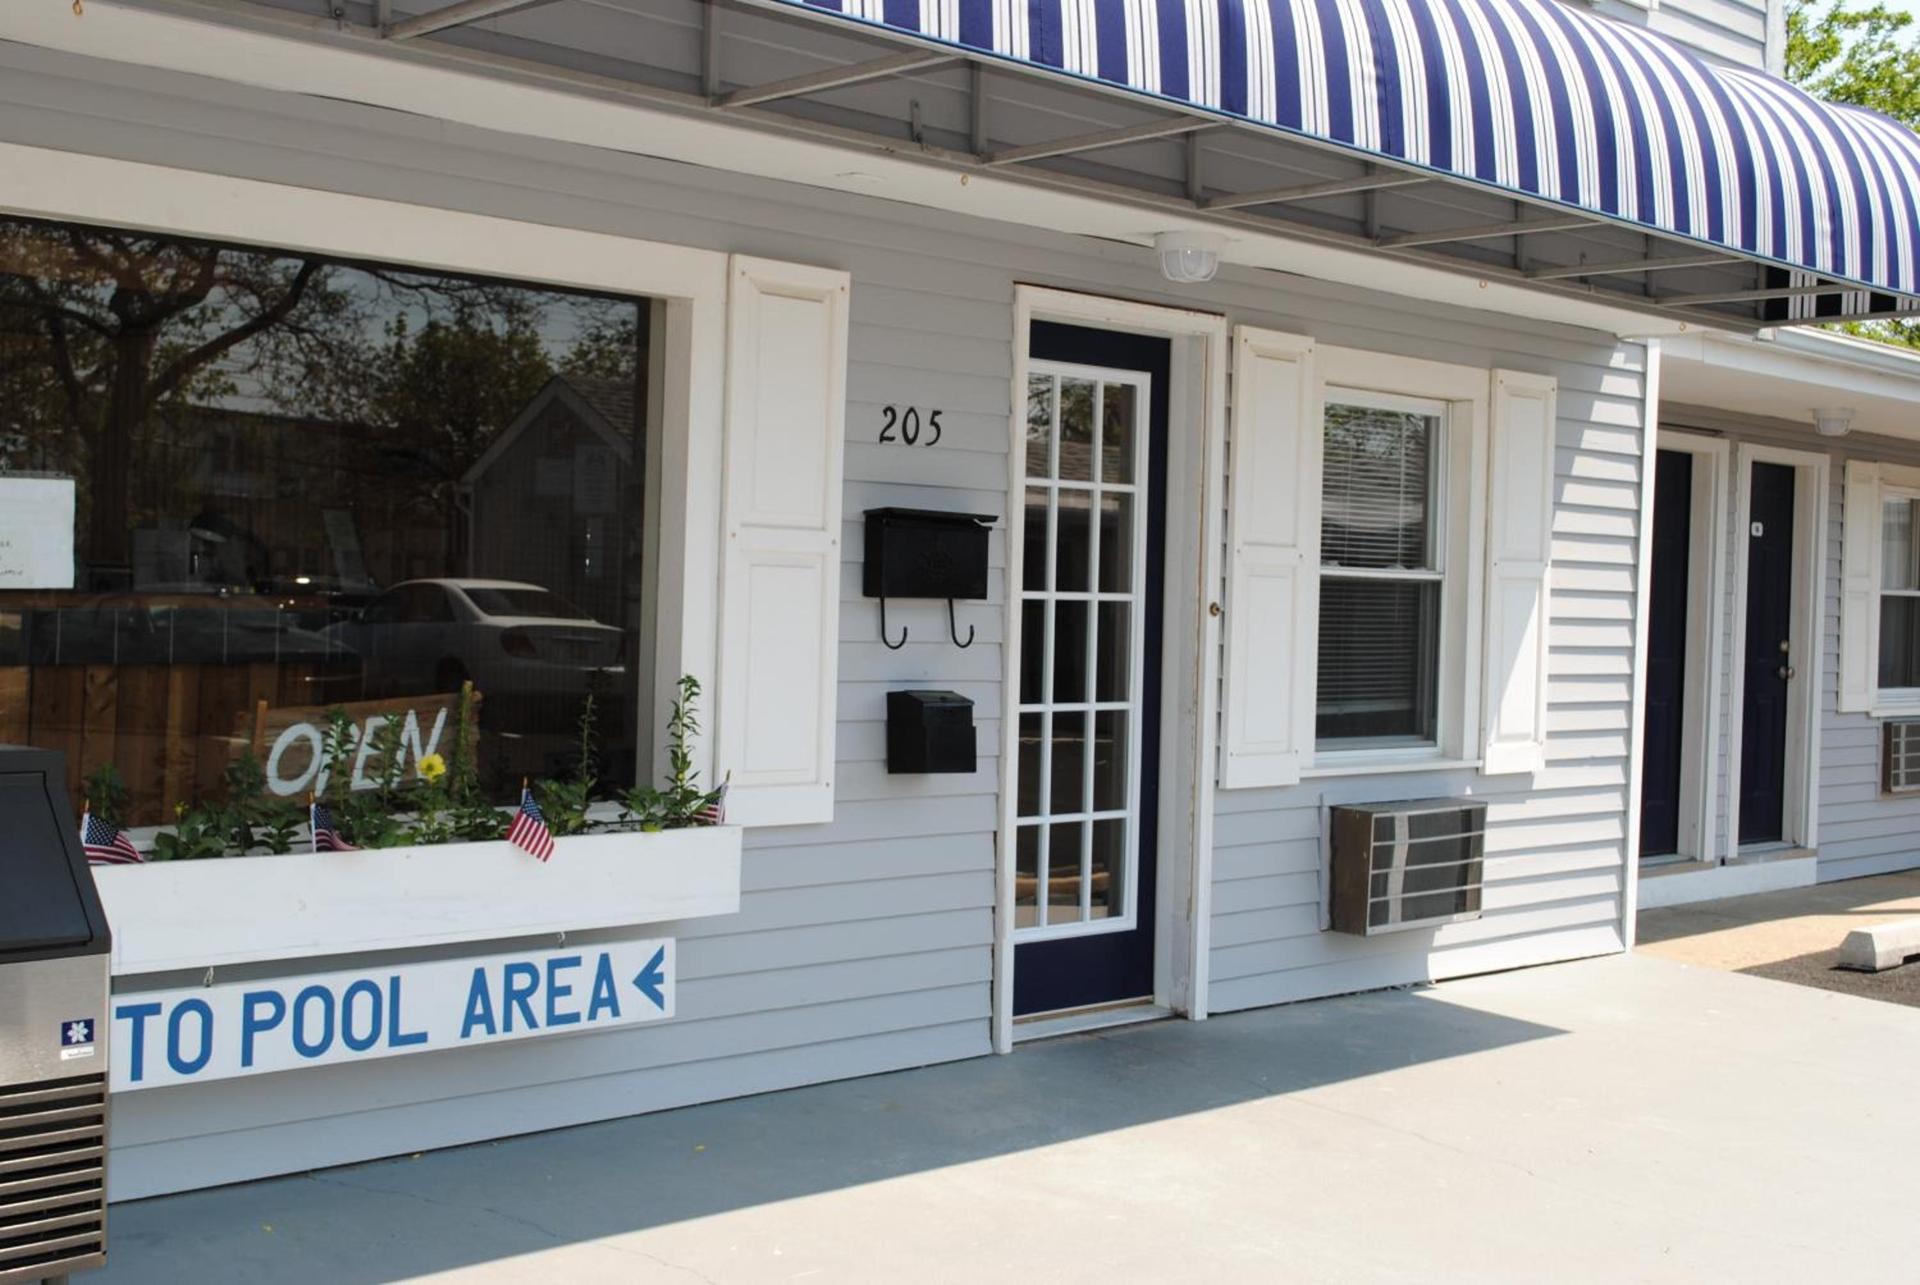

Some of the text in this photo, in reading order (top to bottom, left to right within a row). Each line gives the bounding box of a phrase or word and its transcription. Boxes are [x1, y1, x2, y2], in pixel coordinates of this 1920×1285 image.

[879, 405, 943, 446] 205
[266, 707, 448, 797] OPEN
[115, 950, 620, 1082] TO POOL AREA
